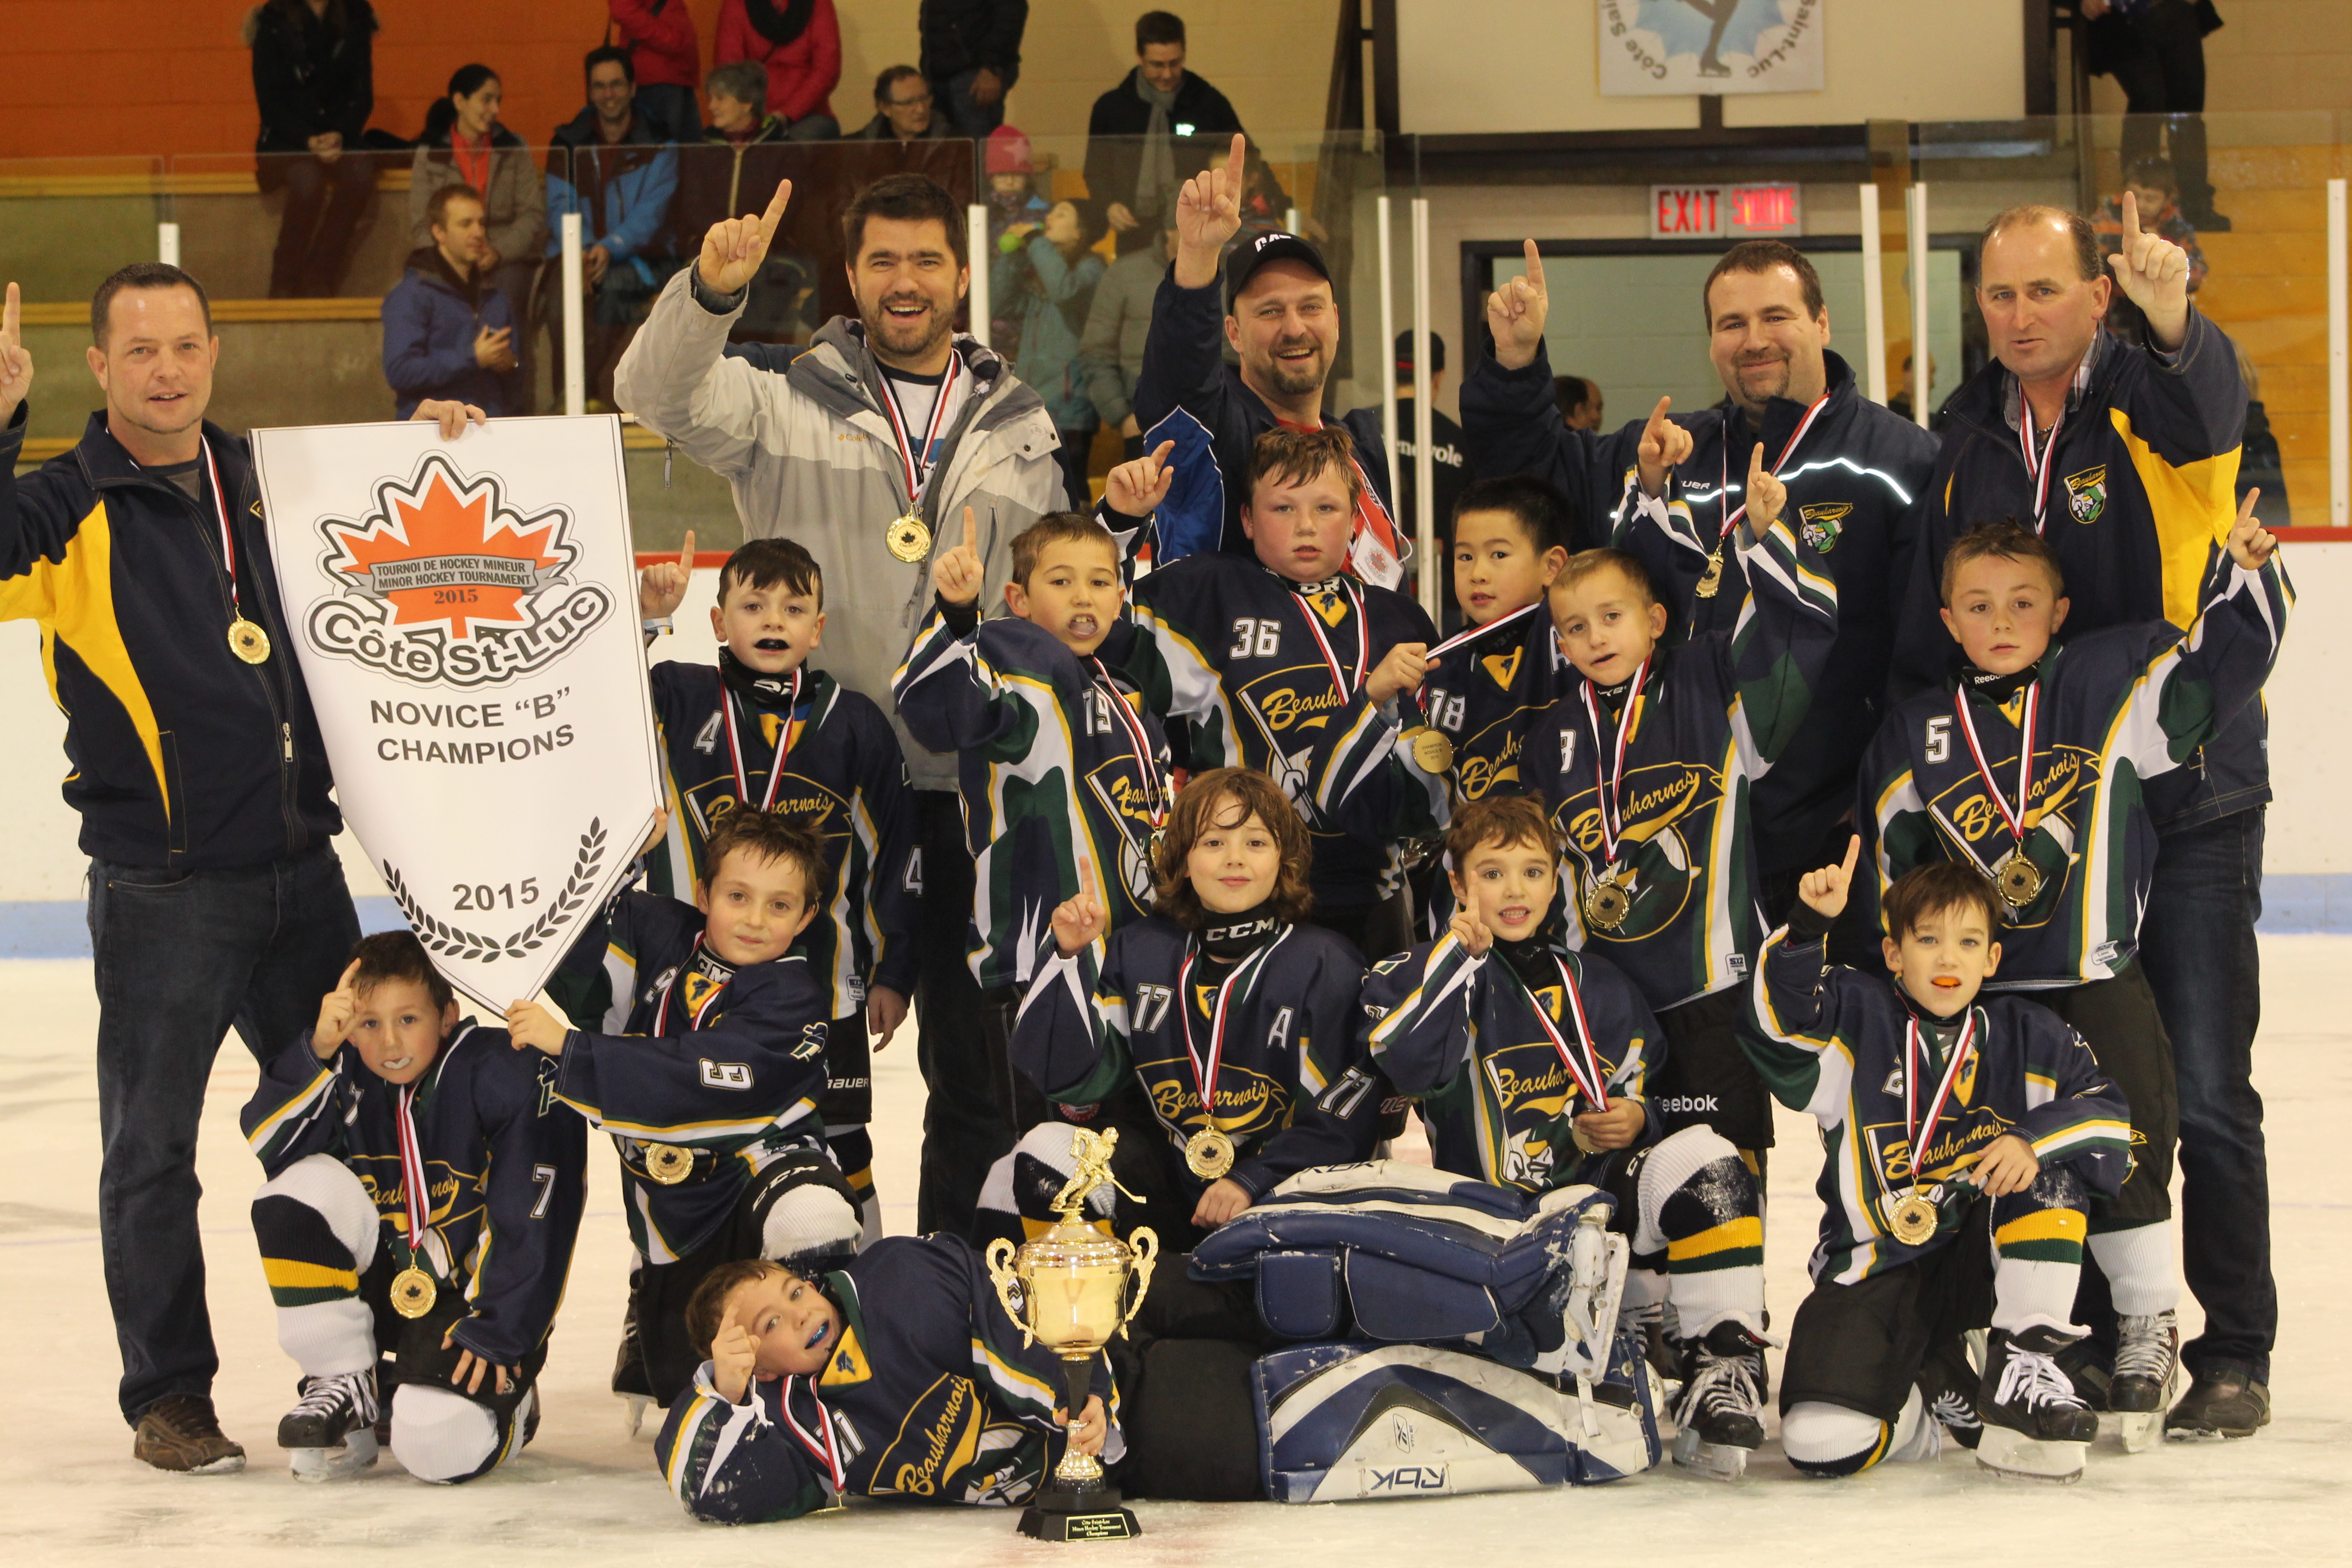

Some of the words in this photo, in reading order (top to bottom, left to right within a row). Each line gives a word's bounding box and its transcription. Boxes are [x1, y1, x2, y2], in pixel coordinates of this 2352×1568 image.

[1658, 191, 1720, 233] EXIT
[1732, 187, 1796, 226] SORTIE
[376, 562, 421, 577] TOURNOI
[424, 560, 437, 571] DE
[440, 558, 481, 570] HOCKEY
[483, 559, 527, 573] MINEUR
[378, 575, 416, 589] MINOR
[416, 572, 455, 585] HOCKEY
[458, 571, 531, 585] TOURNAMENT
[434, 589, 478, 604] 2015
[325, 612, 432, 673] Côte
[449, 597, 598, 675] St-Luc
[1230, 617, 1281, 659] 36
[370, 700, 505, 728] NOVICE
[514, 686, 571, 719] “B”
[1431, 687, 1465, 733] 18
[377, 724, 575, 764] CHAMPIONS
[694, 710, 724, 755] 4
[1925, 715, 1952, 764] 5
[902, 845, 923, 897] 4
[452, 877, 540, 911] 2015
[1206, 916, 1275, 942] CCM
[1132, 983, 1175, 1034] 17
[1267, 1006, 1295, 1051] A
[1318, 1065, 1377, 1120] 17
[530, 1164, 557, 1218] 7
[895, 1375, 974, 1496] Beauharnois
